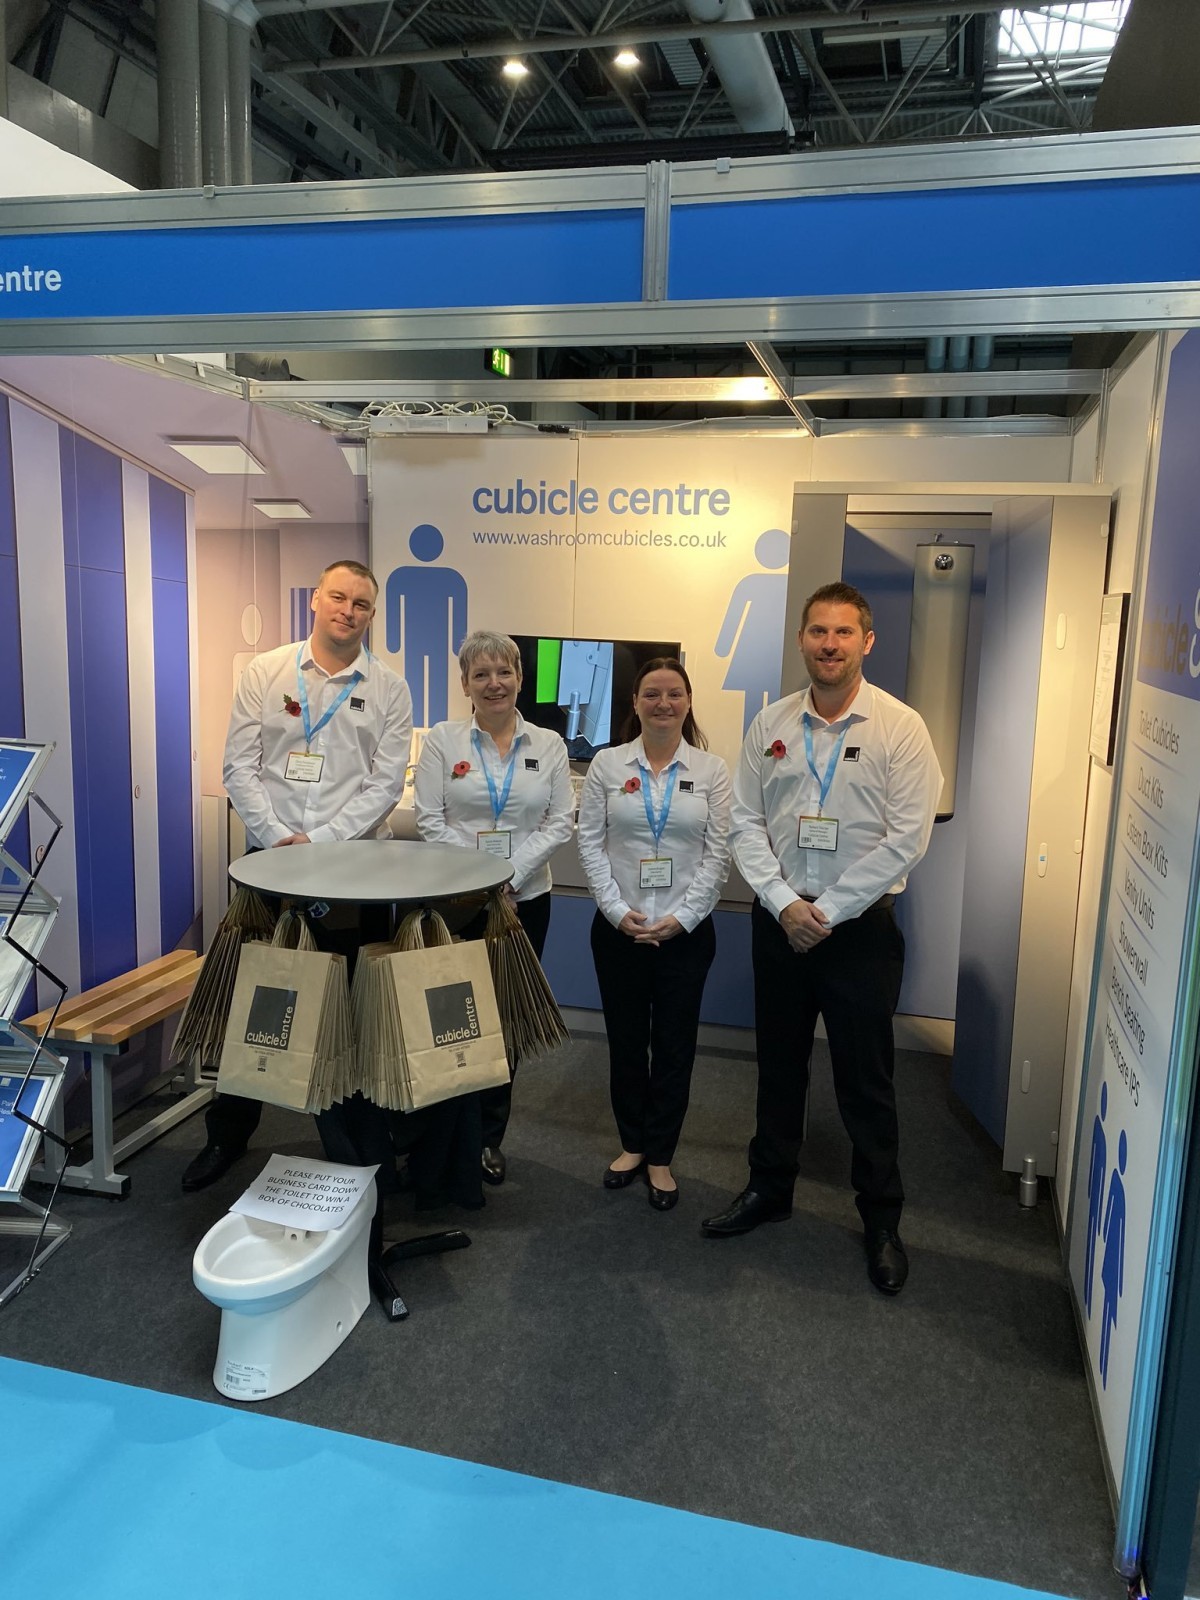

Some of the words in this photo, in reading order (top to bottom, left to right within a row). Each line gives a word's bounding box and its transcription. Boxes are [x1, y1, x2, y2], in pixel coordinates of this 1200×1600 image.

[0, 265, 62, 292] ntre
[472, 478, 599, 516] cubicle
[607, 483, 731, 516] centre
[472, 530, 727, 548] www.washroomcubicles.co.uk
[1140, 710, 1152, 740] Toilet
[1152, 716, 1180, 755] Cubicles
[1137, 766, 1151, 799] Duct
[1151, 775, 1164, 809] Kits
[1127, 814, 1142, 851] Cistern
[1142, 830, 1154, 864] Box
[1154, 841, 1169, 878] Kits
[1125, 867, 1139, 912] Vanity
[1138, 888, 1155, 930] Units
[1119, 920, 1149, 986] Showerwall
[246, 1031, 280, 1046] cubicle
[279, 1006, 294, 1047] centre
[435, 1027, 471, 1044] cubicle
[465, 996, 479, 1036] centre
[1111, 965, 1124, 1010] Bench
[1124, 994, 1146, 1055] Seating
[1105, 1014, 1129, 1085] Healthcare
[1129, 1067, 1141, 1107] IPS
[265, 1185, 281, 1194] THE
[283, 1189, 312, 1199] TOILET
[267, 1176, 306, 1188] BUSINESS
[307, 1183, 331, 1192] CARD
[331, 1186, 359, 1194] DOWN
[283, 1169, 313, 1179] PLEASE
[314, 1173, 332, 1182] PUT
[331, 1176, 356, 1185] YOUR
[258, 1194, 276, 1203] BOX
[277, 1198, 289, 1206] OF
[290, 1200, 344, 1213] CHOCOLATES
